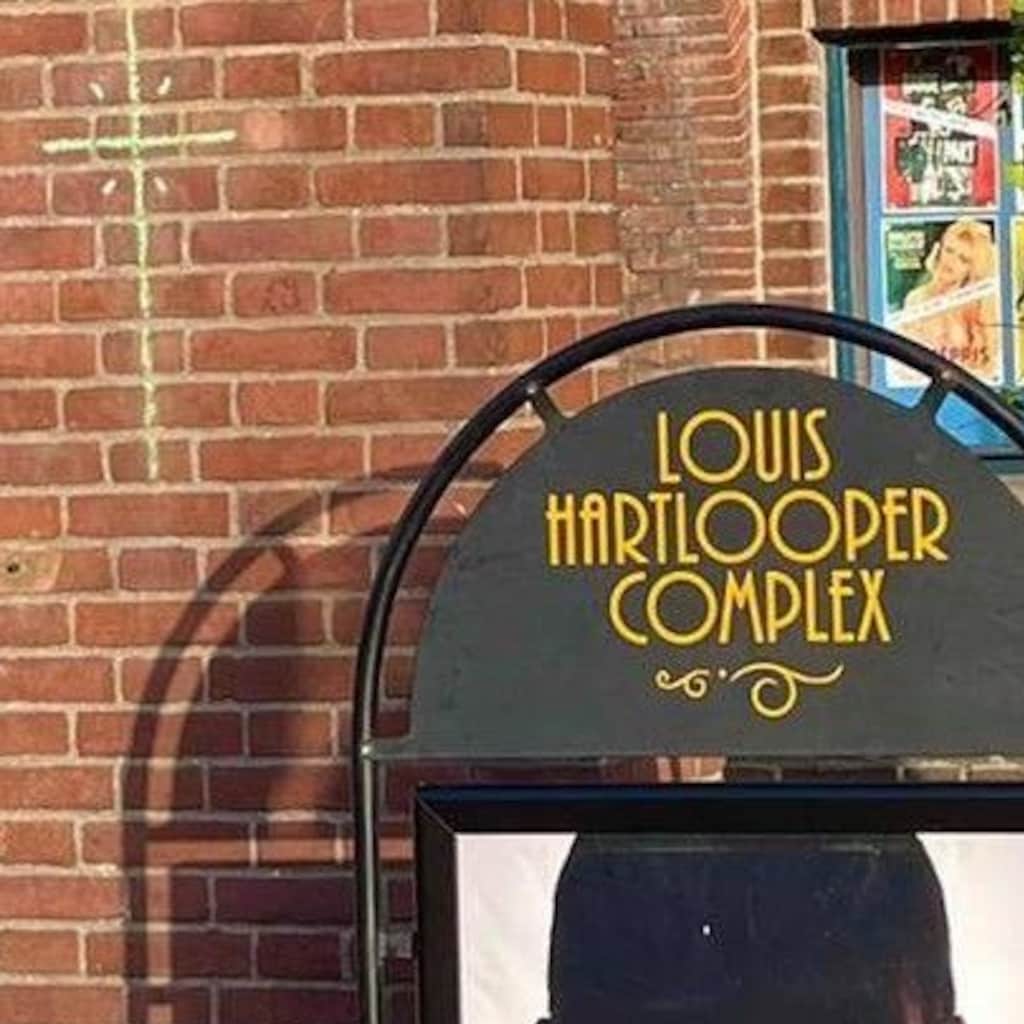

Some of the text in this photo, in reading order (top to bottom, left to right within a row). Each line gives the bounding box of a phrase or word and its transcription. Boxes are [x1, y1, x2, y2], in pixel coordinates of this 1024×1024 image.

[656, 408, 832, 485] LOUIS
[545, 488, 950, 566] HARTLOOPER
[609, 569, 891, 645] COMPLEX
